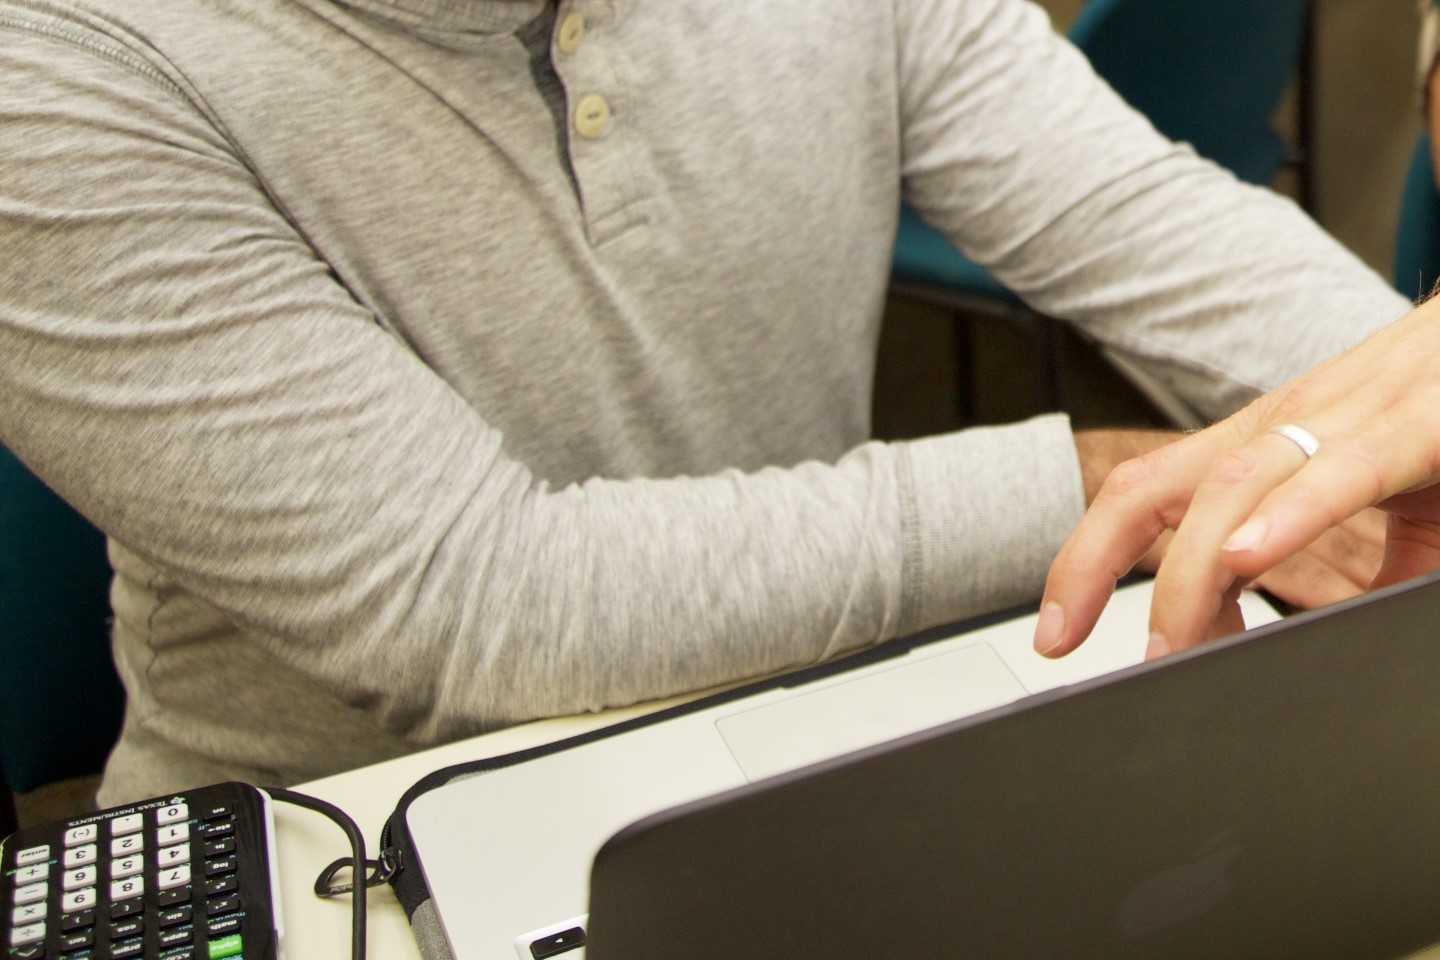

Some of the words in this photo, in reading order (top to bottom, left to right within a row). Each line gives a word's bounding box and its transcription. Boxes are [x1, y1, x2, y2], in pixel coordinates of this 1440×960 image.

[138, 800, 167, 811] TEXAS
[168, 808, 178, 816] 0
[69, 807, 134, 827] INSTRUMENTS
[171, 829, 178, 837] 1
[122, 839, 133, 848] 2
[21, 848, 48, 858] enter
[75, 850, 86, 858] 3
[169, 850, 180, 858] 4
[122, 861, 133, 870] 5
[75, 872, 86, 880] 6
[170, 871, 180, 880] 7
[122, 883, 133, 891] 8
[74, 894, 85, 903] 9
[117, 924, 137, 932] cos
[210, 920, 237, 930] math
[68, 936, 87, 945] tan
[162, 932, 189, 942] apps
[112, 943, 141, 955] prgm
[211, 940, 238, 951] alpha
